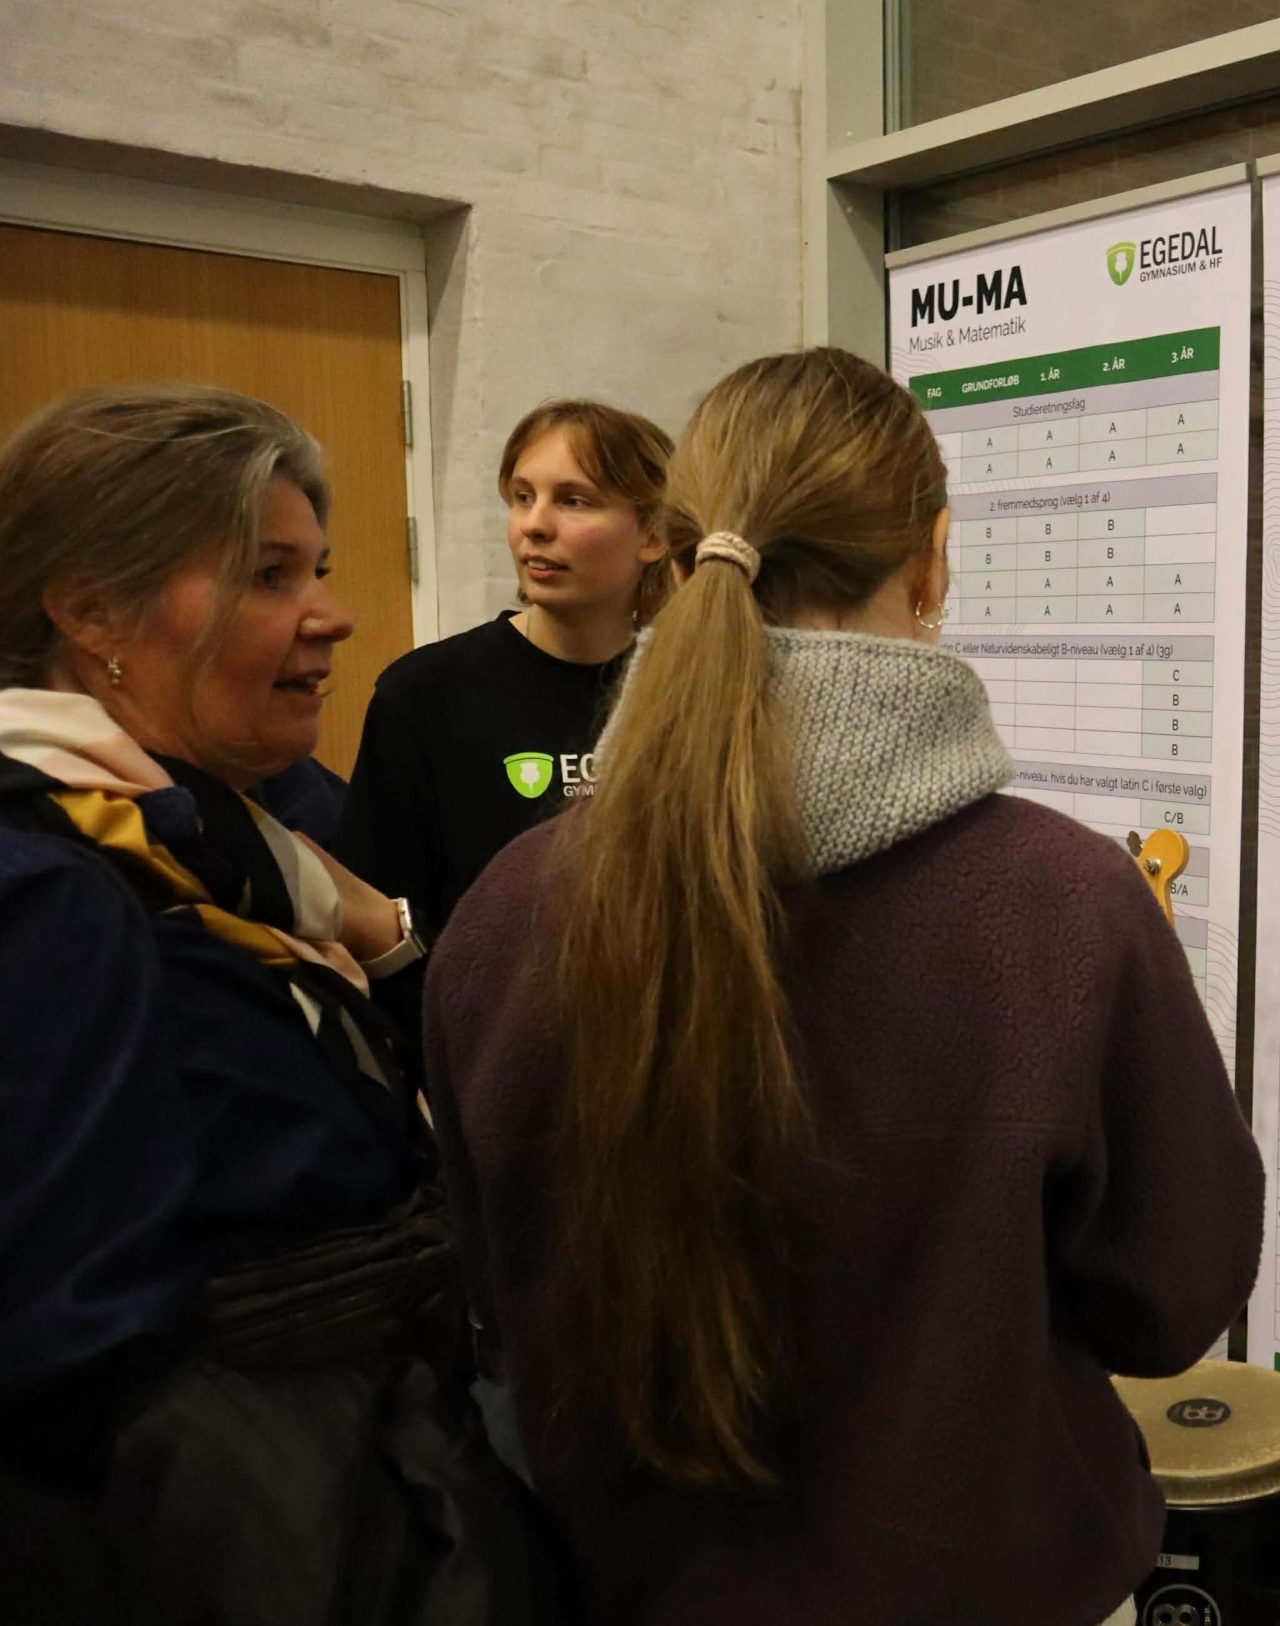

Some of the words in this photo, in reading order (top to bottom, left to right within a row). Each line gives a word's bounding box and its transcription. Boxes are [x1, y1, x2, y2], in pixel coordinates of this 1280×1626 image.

[1140, 226, 1223, 269] EGEDAL
[1140, 262, 1197, 283] GYMNASIUM
[1199, 261, 1207, 271] &
[1209, 257, 1222, 269] HF
[911, 265, 1027, 327] MU-MA
[909, 331, 943, 353] Musik
[946, 331, 956, 347] &
[959, 317, 1026, 343] Matematik
[927, 388, 941, 399] FAG
[962, 375, 1019, 393] GRUNDFORLØB
[1041, 372, 1047, 381] 1.
[1048, 369, 1059, 381] ÅR
[1103, 362, 1110, 372] 2.
[1112, 358, 1125, 370] ÅR
[1171, 352, 1178, 363] 3.
[1180, 347, 1194, 360] ÅR
[1013, 398, 1086, 418] Studieretningsfag
[987, 438, 993, 448] A
[1046, 430, 1053, 440] A
[1109, 422, 1116, 433] A
[1177, 414, 1184, 425] A
[990, 501, 995, 511] 2.
[997, 497, 1058, 510] fremmedsprog
[1060, 495, 1082, 507] (vælg
[1085, 495, 1089, 505] 1
[1092, 492, 1100, 504] af
[1102, 491, 1110, 503] 4)
[986, 528, 992, 538] B
[1045, 524, 1051, 535] B
[1108, 519, 1115, 531] B
[985, 580, 991, 590] A
[1045, 578, 1051, 589] A
[1106, 576, 1114, 587] A
[1175, 574, 1182, 585] A
[955, 643, 960, 653] C
[963, 643, 979, 654] eller
[981, 642, 1059, 657] Naturvidenskabeligt
[1061, 641, 1098, 656] B-niveau
[1100, 642, 1126, 658] (vælg
[1129, 644, 1133, 656] 1
[1135, 643, 1144, 656] af
[1146, 644, 1155, 657] 4)
[1156, 644, 1173, 658] (3g)
[1173, 670, 1180, 681] C
[1172, 745, 1178, 755] B
[1051, 772, 1065, 784] hvis
[1068, 775, 1078, 785] du
[1080, 776, 1093, 787] har
[1096, 779, 1118, 791] valgt
[1121, 780, 1139, 790] latin
[1142, 780, 1149, 791] C
[1156, 782, 1181, 794] første
[1183, 785, 1207, 799] valg)
[1164, 811, 1184, 824] C/B
[1170, 883, 1188, 896] B/A
